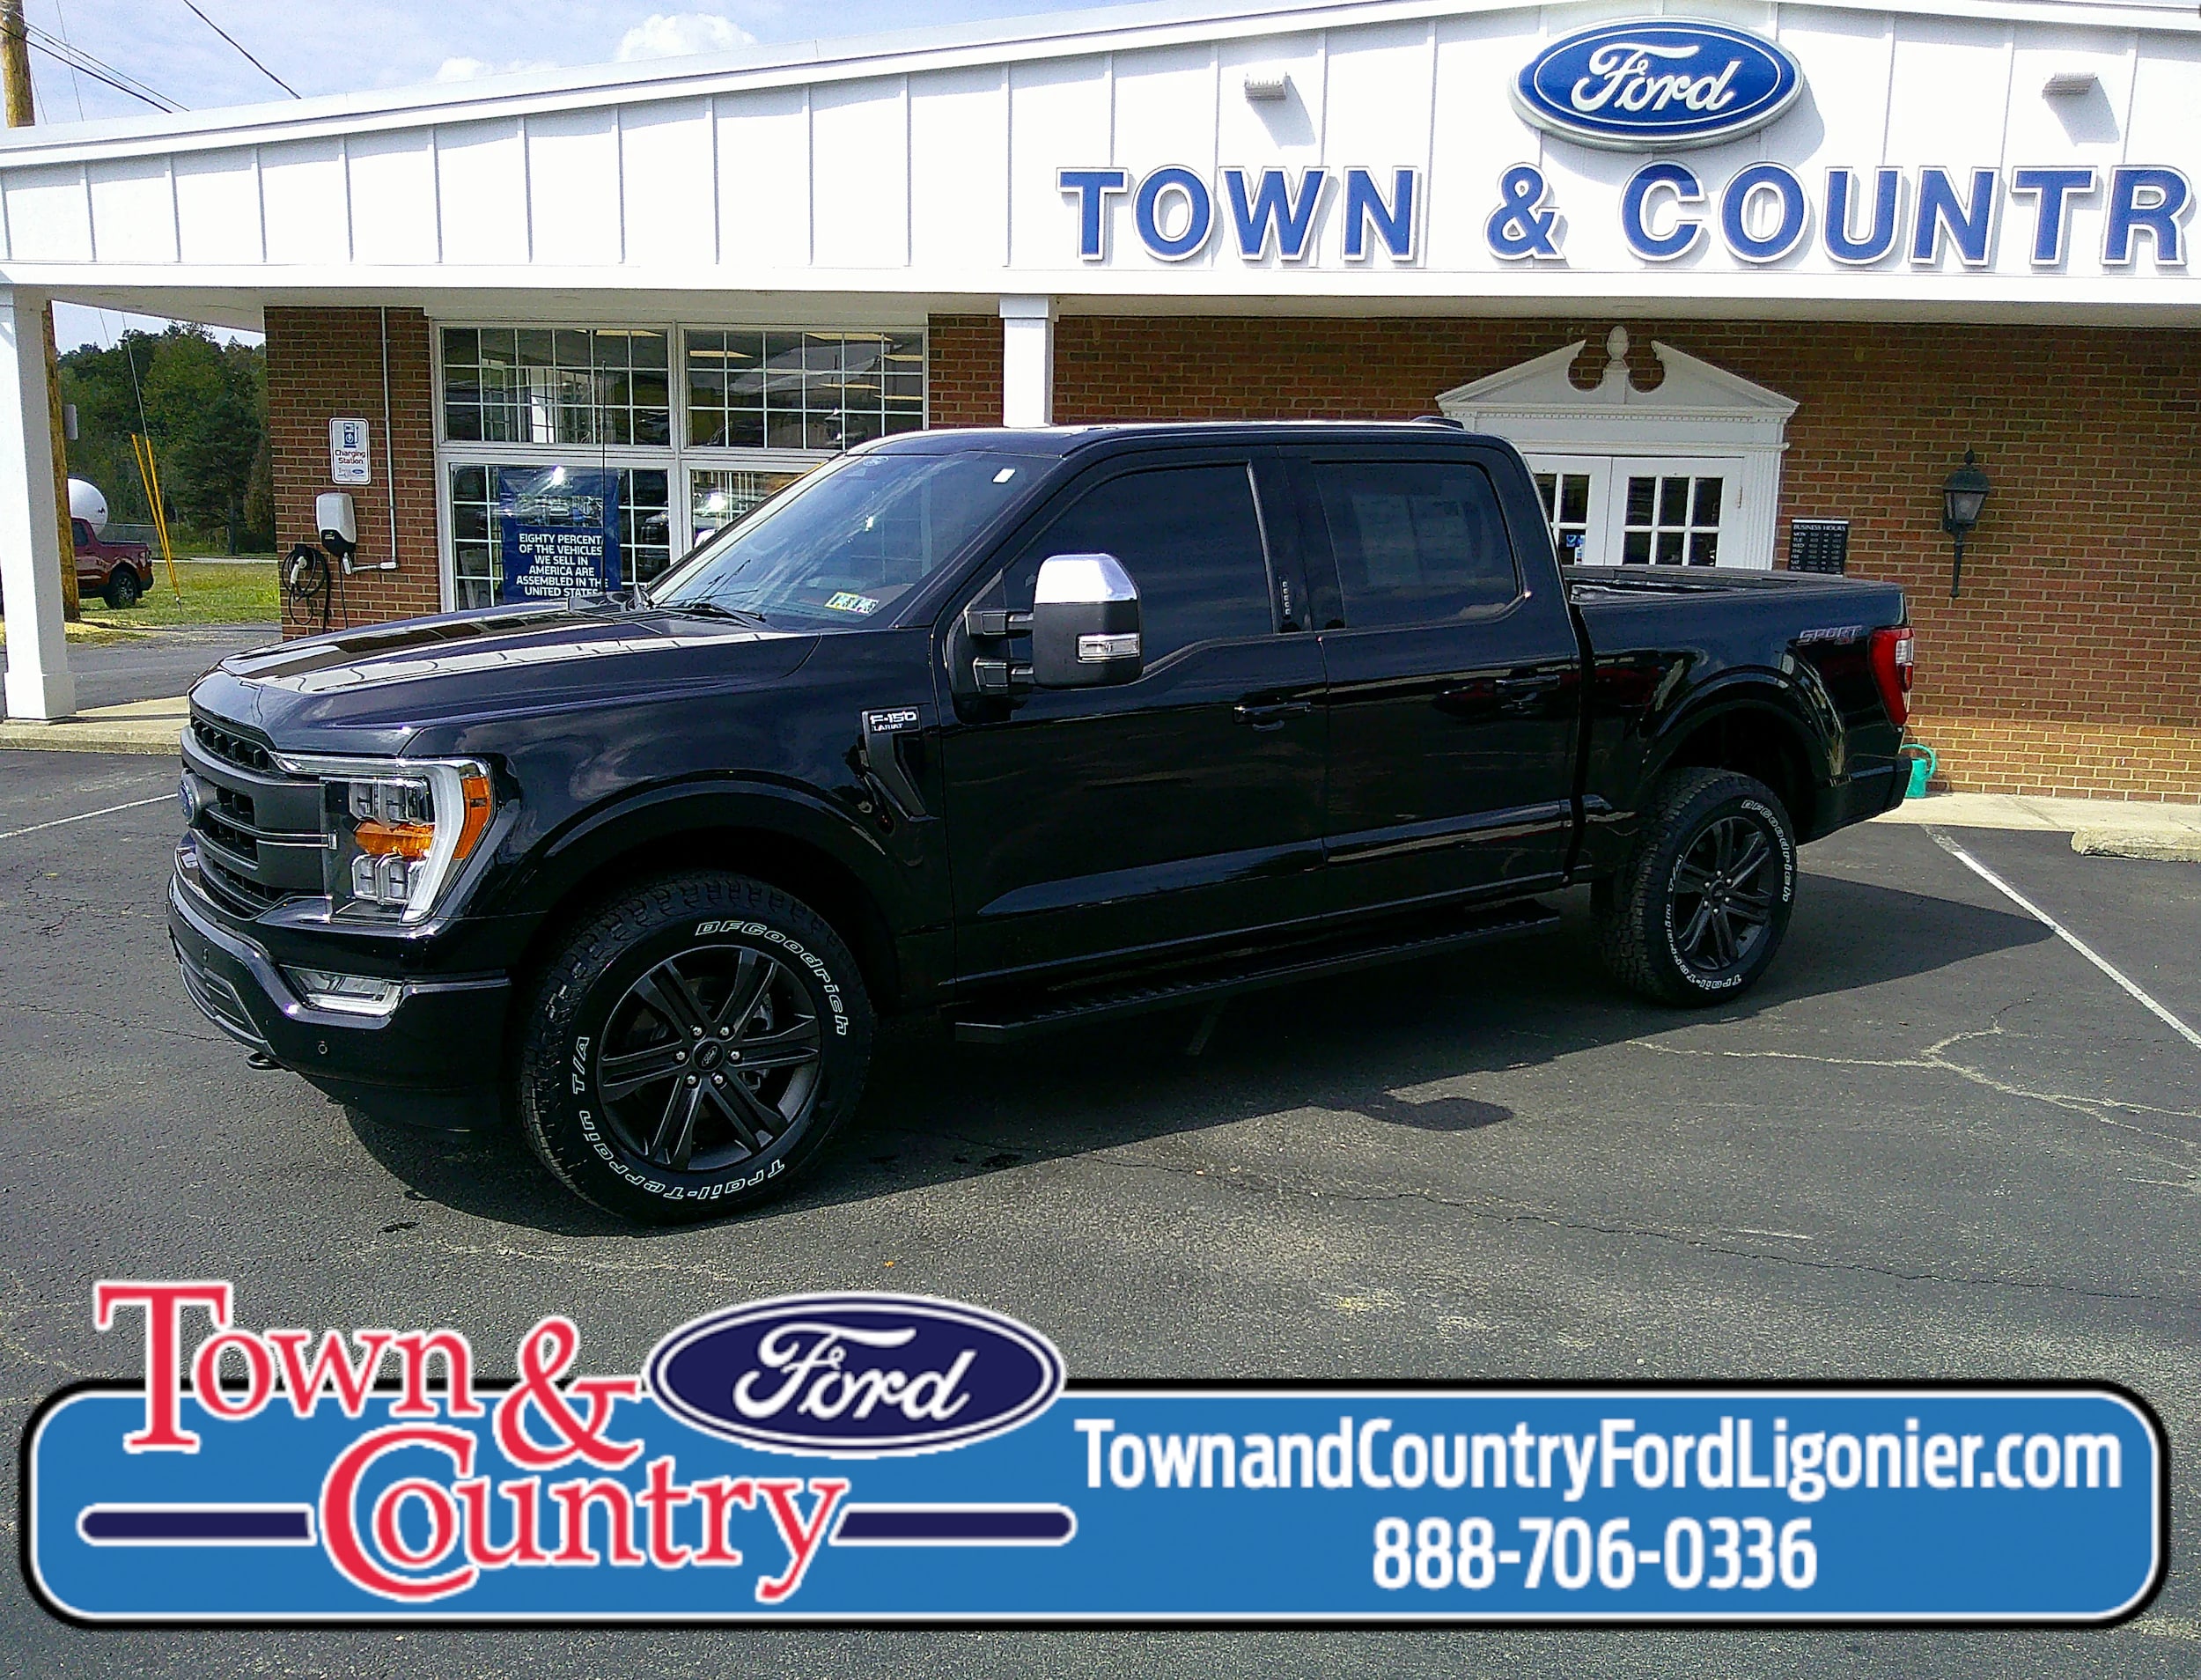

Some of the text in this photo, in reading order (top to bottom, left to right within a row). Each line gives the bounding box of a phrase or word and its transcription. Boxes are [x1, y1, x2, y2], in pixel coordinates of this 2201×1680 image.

[1571, 42, 1741, 112] Ford
[1058, 160, 2189, 264] TOWN & COUNTR
[519, 533, 602, 545] EIGHTY PERCENT
[519, 544, 602, 556] OF THE VEHICLES
[534, 555, 588, 565] WE SELL IN
[529, 565, 595, 577] AMERICA ARE
[516, 576, 608, 588] ASSEMBLED IN THE
[524, 586, 562, 596] UNITED
[1796, 625, 1863, 646] SPORT
[870, 711, 916, 725] F-150
[872, 723, 904, 732] LARIAT
[695, 919, 850, 1036] BFGoodrich
[572, 1035, 785, 1200] Trail-Terrain T/A
